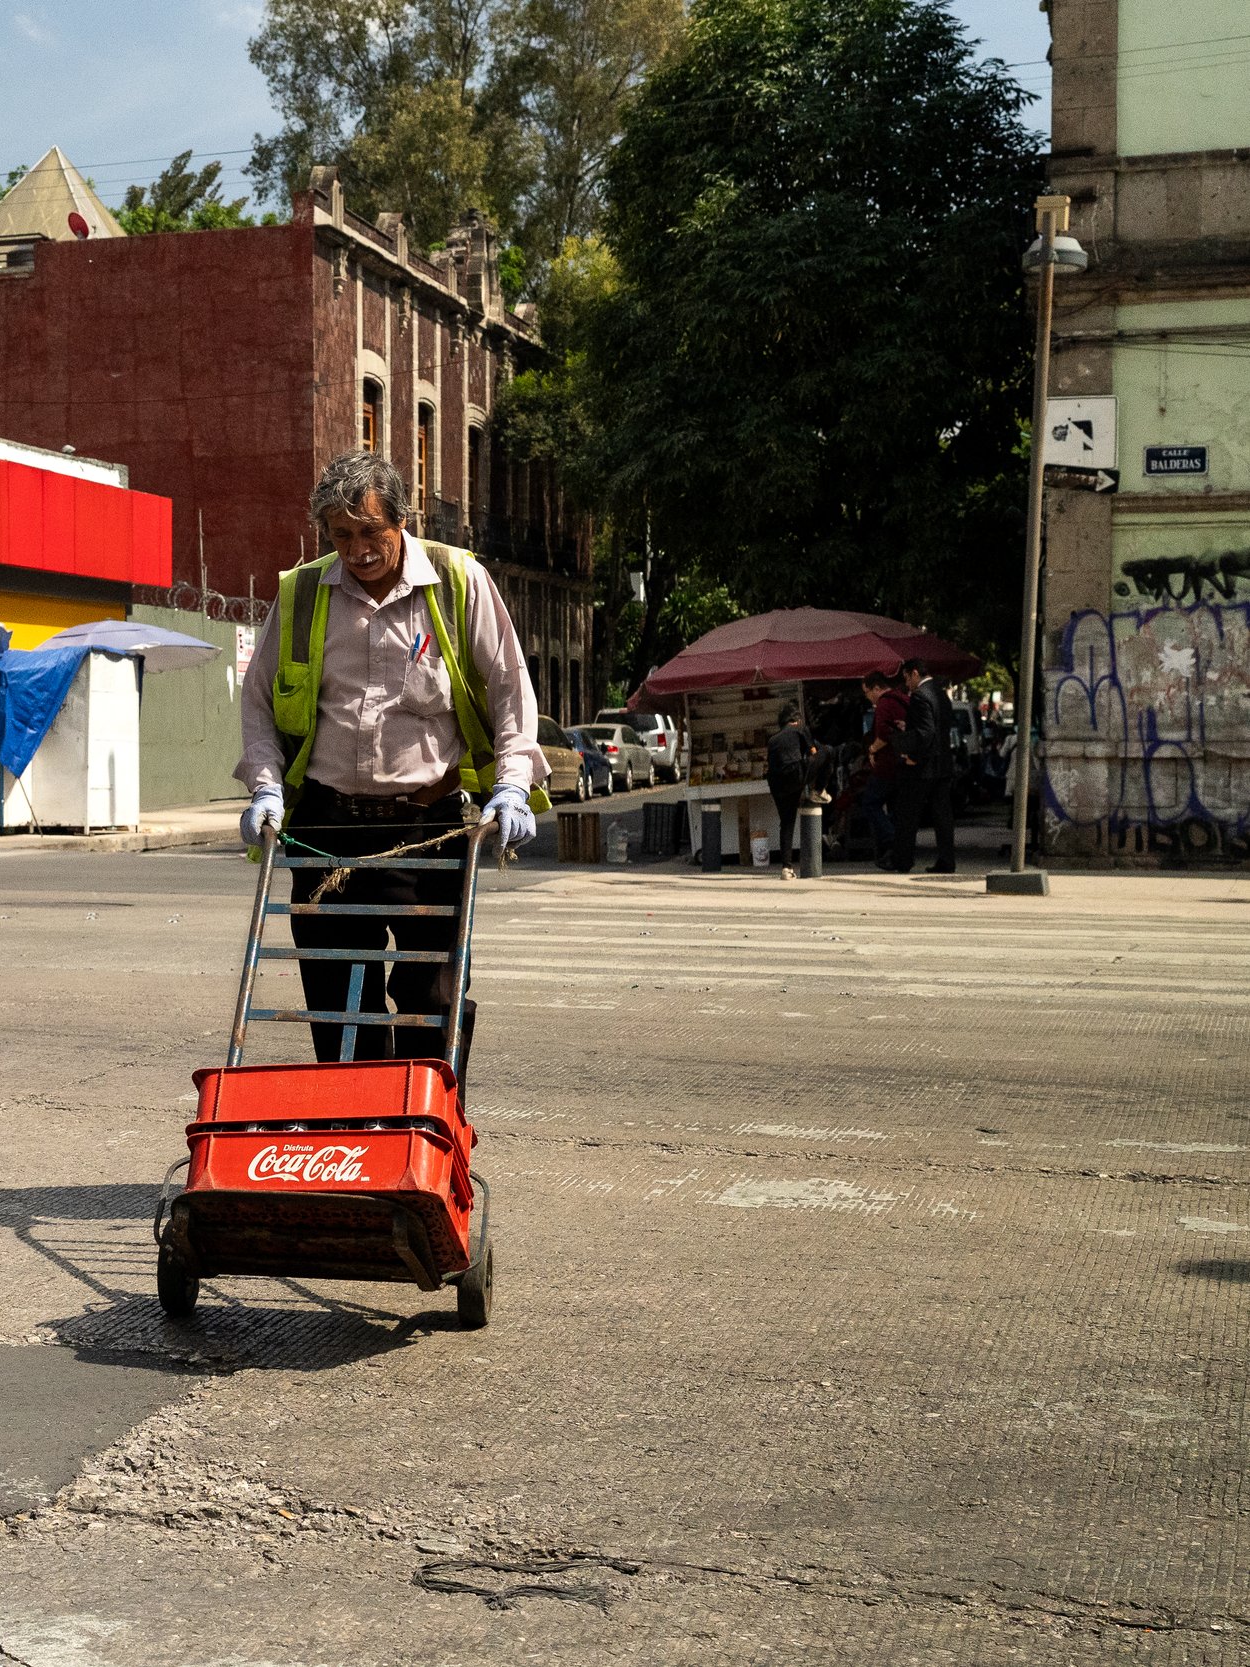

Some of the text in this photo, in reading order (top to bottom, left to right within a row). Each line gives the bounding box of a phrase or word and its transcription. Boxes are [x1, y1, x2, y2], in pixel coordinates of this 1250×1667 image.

[1150, 458, 1201, 471] BALDERAS
[283, 1144, 314, 1152] Disfruta
[247, 1145, 370, 1182] Coca-Cola
